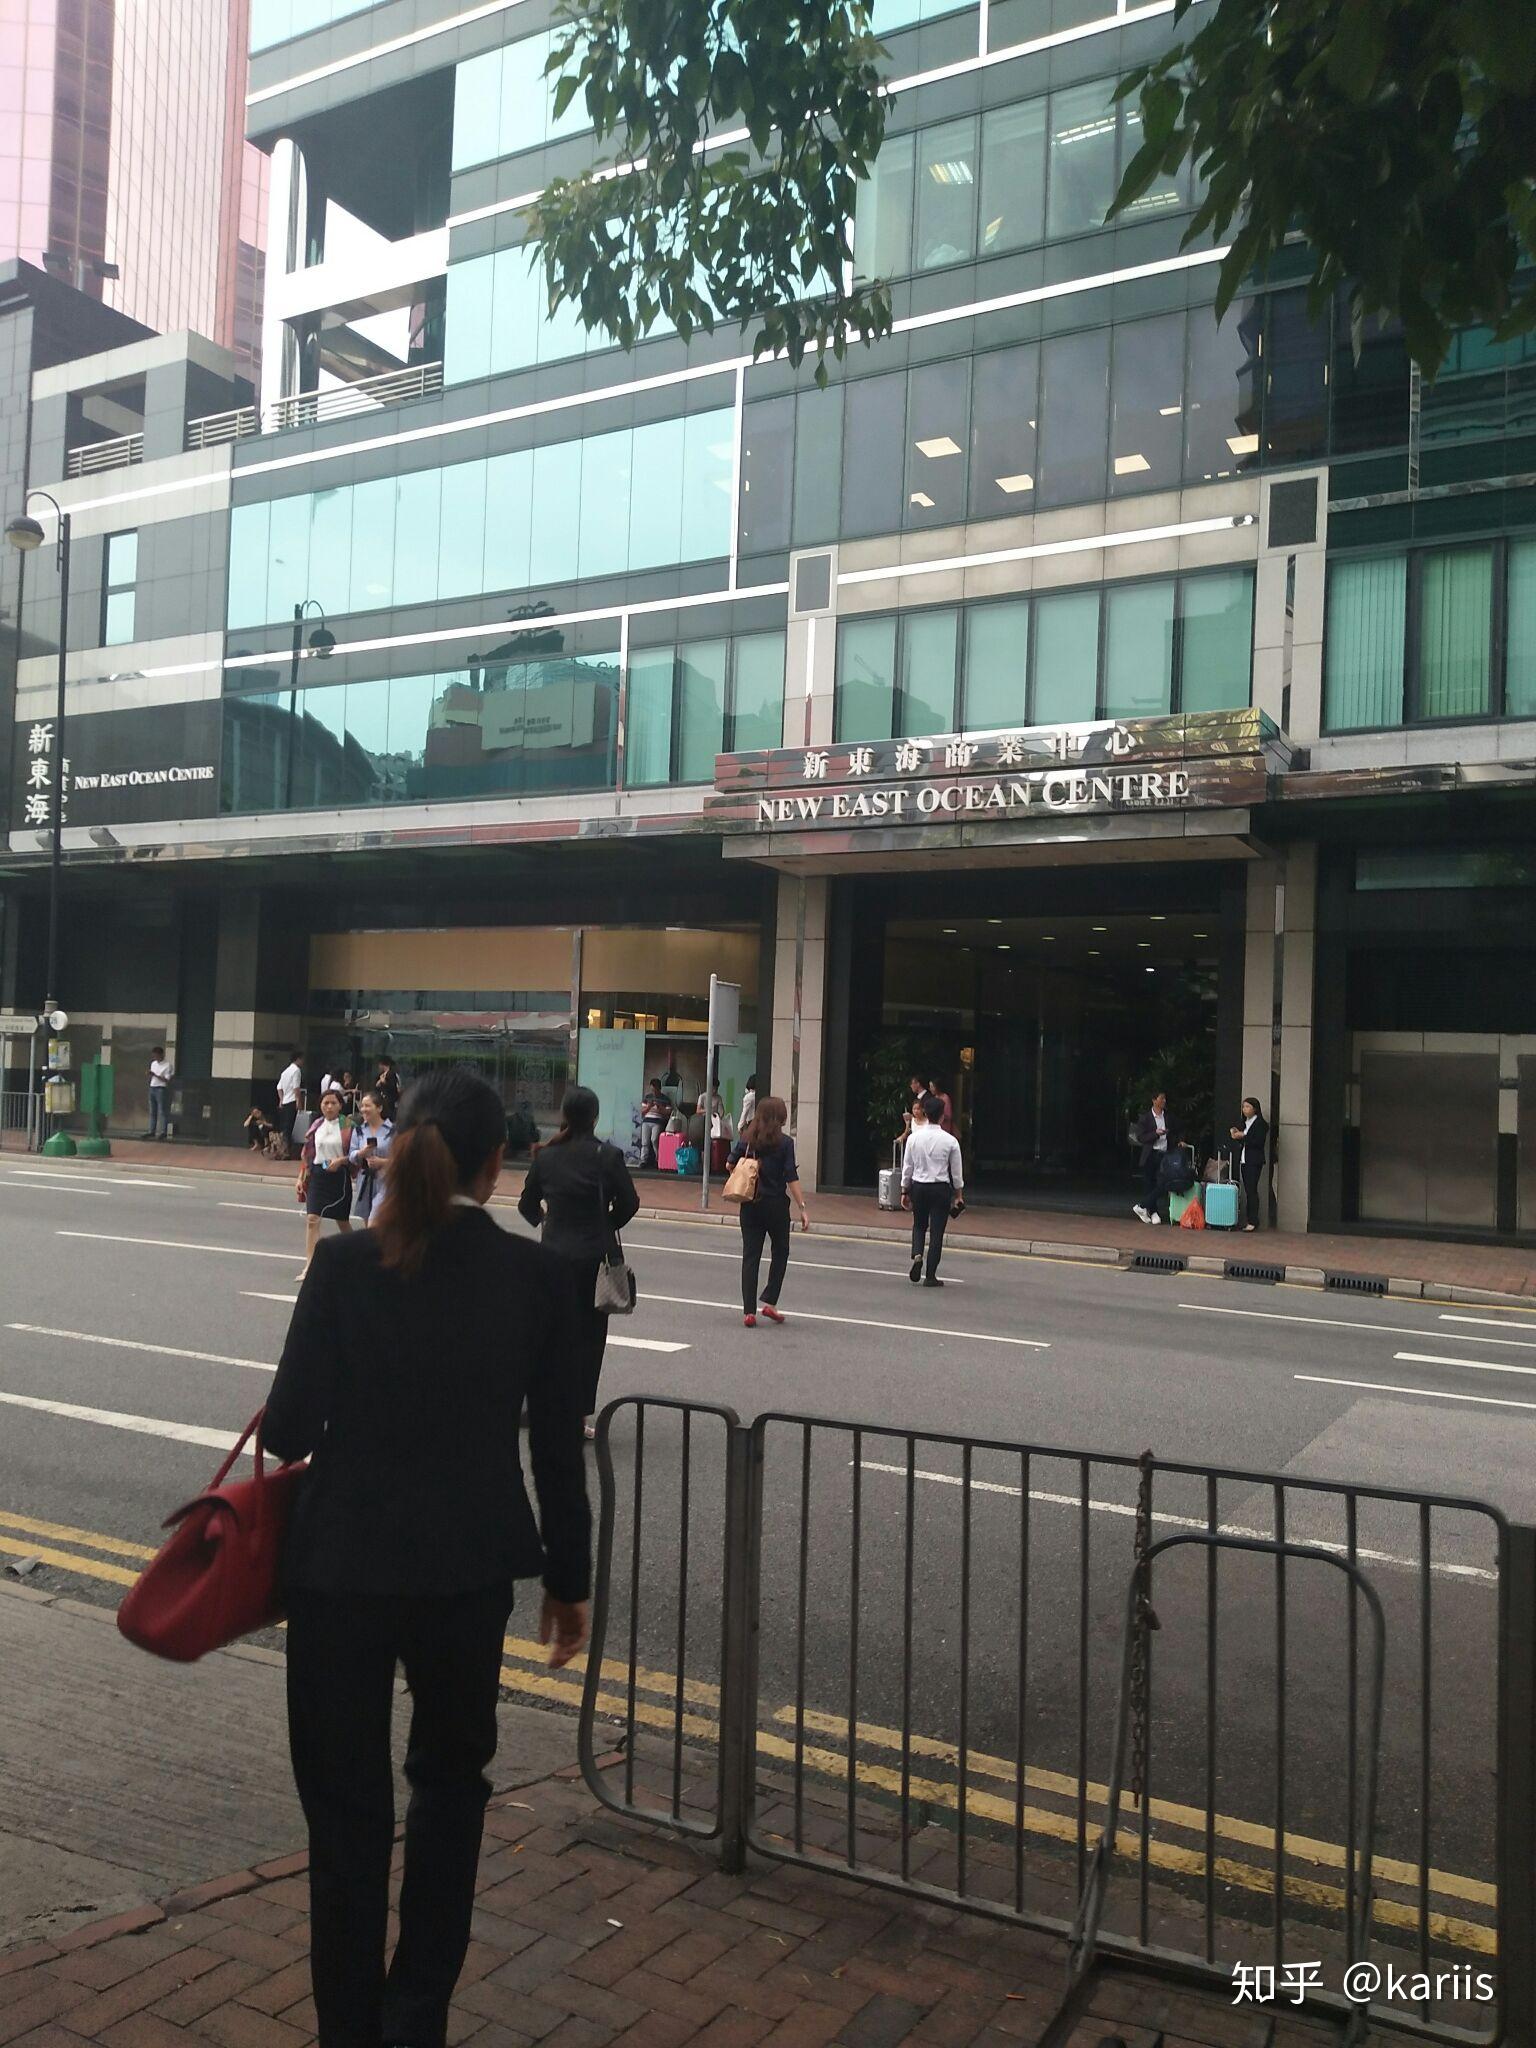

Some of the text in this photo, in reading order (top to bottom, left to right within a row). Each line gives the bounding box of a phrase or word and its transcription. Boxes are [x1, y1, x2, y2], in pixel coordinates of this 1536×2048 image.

[24, 723, 55, 824] 新東海
[803, 725, 1142, 778] 新東海商業中心
[757, 798, 822, 822] NEW
[832, 790, 909, 818] EAST
[917, 783, 1031, 813] OCEAN
[1042, 771, 1190, 806] CENTRE
